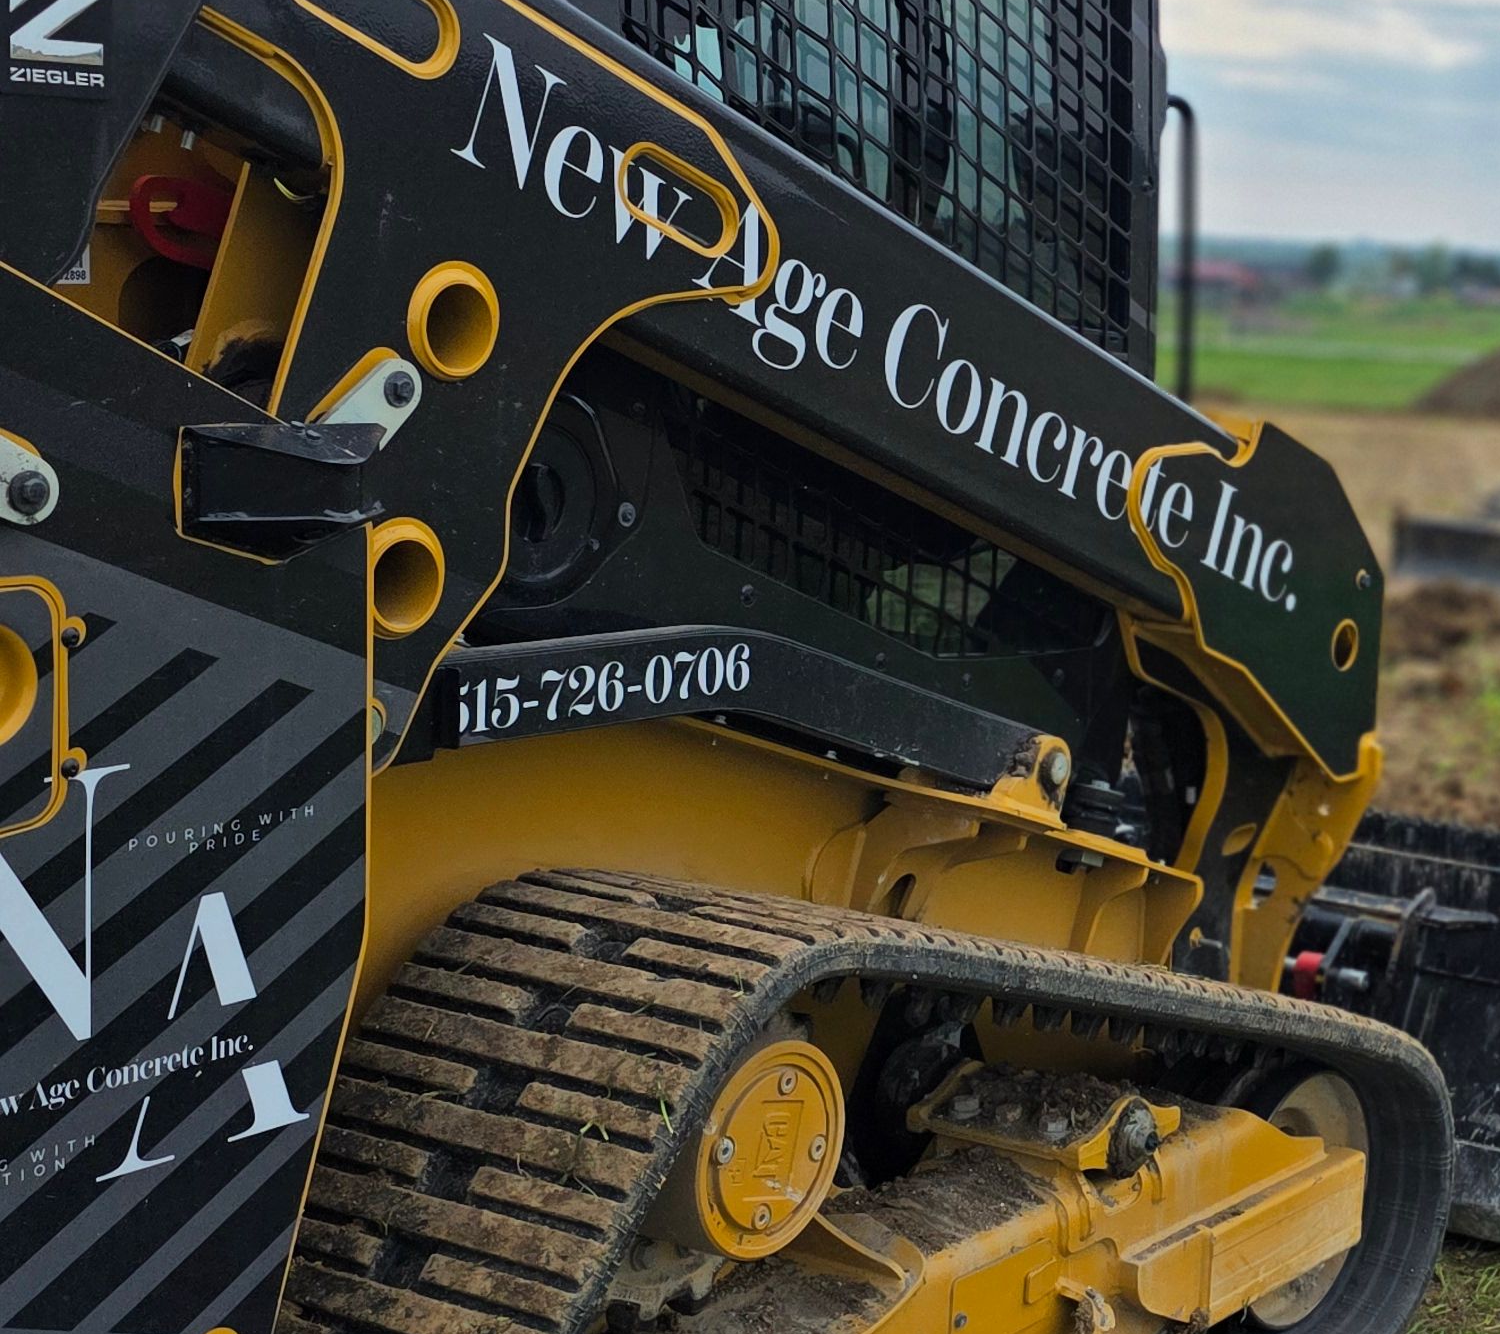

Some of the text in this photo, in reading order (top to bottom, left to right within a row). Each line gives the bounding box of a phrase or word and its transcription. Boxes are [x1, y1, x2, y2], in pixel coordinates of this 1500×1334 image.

[9, 67, 105, 87] ZIEGLER
[450, 32, 1297, 613] New Age Concrete Inc.
[128, 804, 314, 851] POURING WITH
[189, 828, 261, 854] PRIDE
[28, 1078, 80, 1111] Age
[86, 1043, 204, 1094] Concrete
[211, 1034, 254, 1061] Inc.
[30, 1134, 96, 1163] WITH
